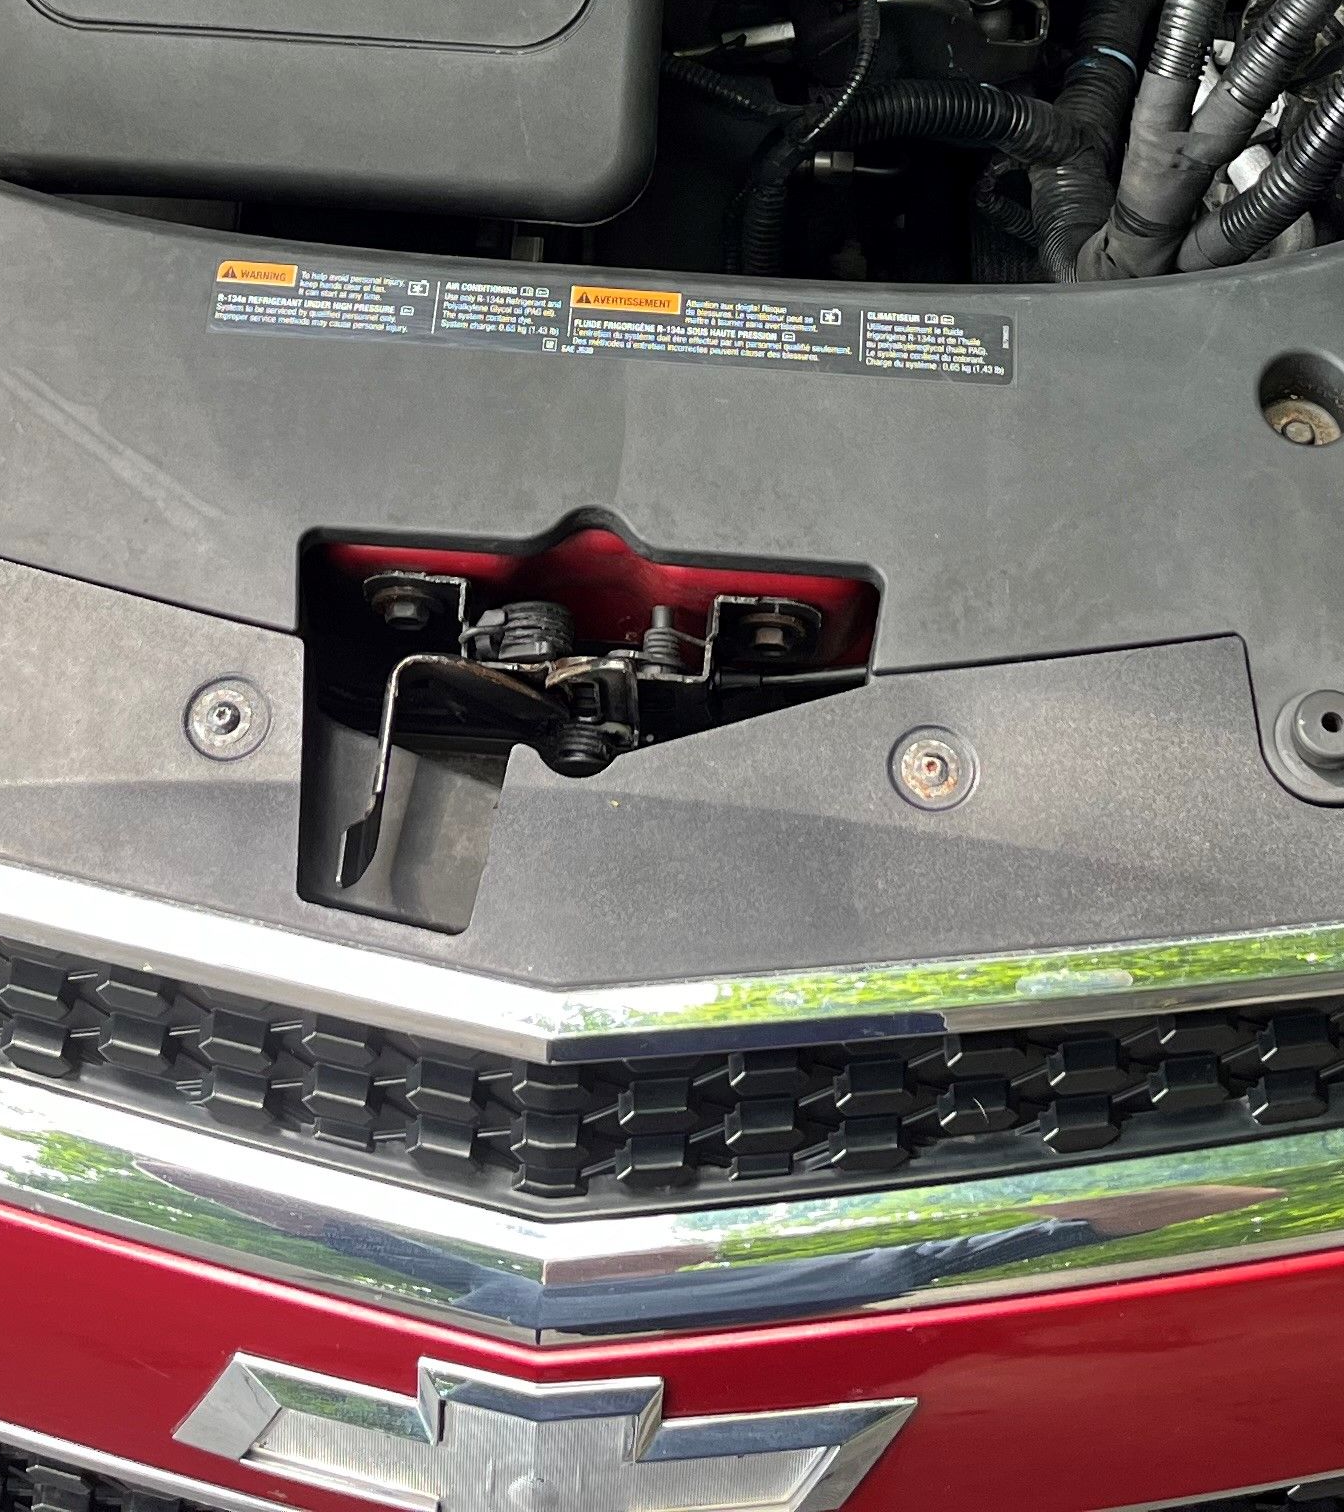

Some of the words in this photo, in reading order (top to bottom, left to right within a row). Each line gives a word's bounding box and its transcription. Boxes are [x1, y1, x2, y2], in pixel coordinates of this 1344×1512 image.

[241, 270, 286, 281] WARNING
[302, 271, 310, 279] To
[312, 273, 327, 281] help
[330, 275, 349, 283] avoid
[350, 276, 382, 285] personal
[300, 280, 318, 289] keep
[320, 281, 342, 289] hands
[344, 283, 361, 291] clear
[446, 282, 459, 291] AIR
[461, 283, 517, 294] CONDITIONING
[321, 290, 337, 298] start
[348, 293, 362, 301] any
[444, 293, 458, 301] Use
[460, 294, 476, 303] only
[476, 295, 504, 304] R-134a
[506, 297, 546, 306] Refrigerant
[548, 300, 562, 308] and
[593, 296, 672, 308] AVERTISSEMENT
[218, 293, 246, 303] R-134a
[248, 296, 302, 306] REFRIGERANT
[304, 300, 331, 309] UNDER
[333, 302, 352, 310] HIGH
[354, 303, 396, 313] PRESSURE
[490, 305, 512, 314] Glycol
[686, 300, 719, 309] Attention
[720, 302, 734, 310] aux
[762, 304, 787, 314] Risque
[216, 303, 244, 312] System
[246, 304, 253, 313] to
[255, 305, 264, 313] be
[266, 306, 297, 316] serviced
[299, 308, 307, 317] by
[309, 309, 340, 319] qualified
[342, 311, 379, 321] personnel
[443, 310, 456, 318] The
[458, 312, 484, 321] system
[485, 314, 516, 322] contains
[685, 308, 695, 316] de
[786, 315, 803, 324] peut
[867, 312, 920, 322] CLIMATISEUR
[214, 312, 248, 322] Improper
[249, 314, 276, 323] service
[278, 316, 310, 326] methods
[311, 318, 327, 327] may
[329, 320, 351, 328] cause
[353, 321, 384, 331] personal
[441, 319, 468, 329] System
[517, 325, 527, 334] kg
[574, 319, 602, 328] FLUIDE
[657, 326, 685, 335] R-134a
[687, 327, 708, 336] SOUS
[710, 329, 736, 338] HAUTE
[738, 331, 777, 341] PRESSION
[894, 325, 932, 334] seulement
[943, 328, 963, 336] fluide
[624, 333, 655, 342] système
[656, 333, 671, 342] doit
[672, 334, 687, 343] être
[720, 339, 732, 347] par
[745, 342, 782, 350] personnel
[908, 334, 936, 343] R-134a
[937, 336, 945, 344] et
[946, 337, 957, 345] de
[588, 339, 624, 348] méthodes
[667, 343, 708, 353] incorrectes
[710, 348, 739, 356] peuvent
[766, 350, 780, 358] des
[866, 349, 875, 357] Le
[877, 350, 908, 360] système
[910, 353, 940, 362] contient
[941, 354, 951, 362] du
[866, 357, 892, 368] Charge
[894, 360, 904, 368] du
[961, 365, 971, 374] kg
